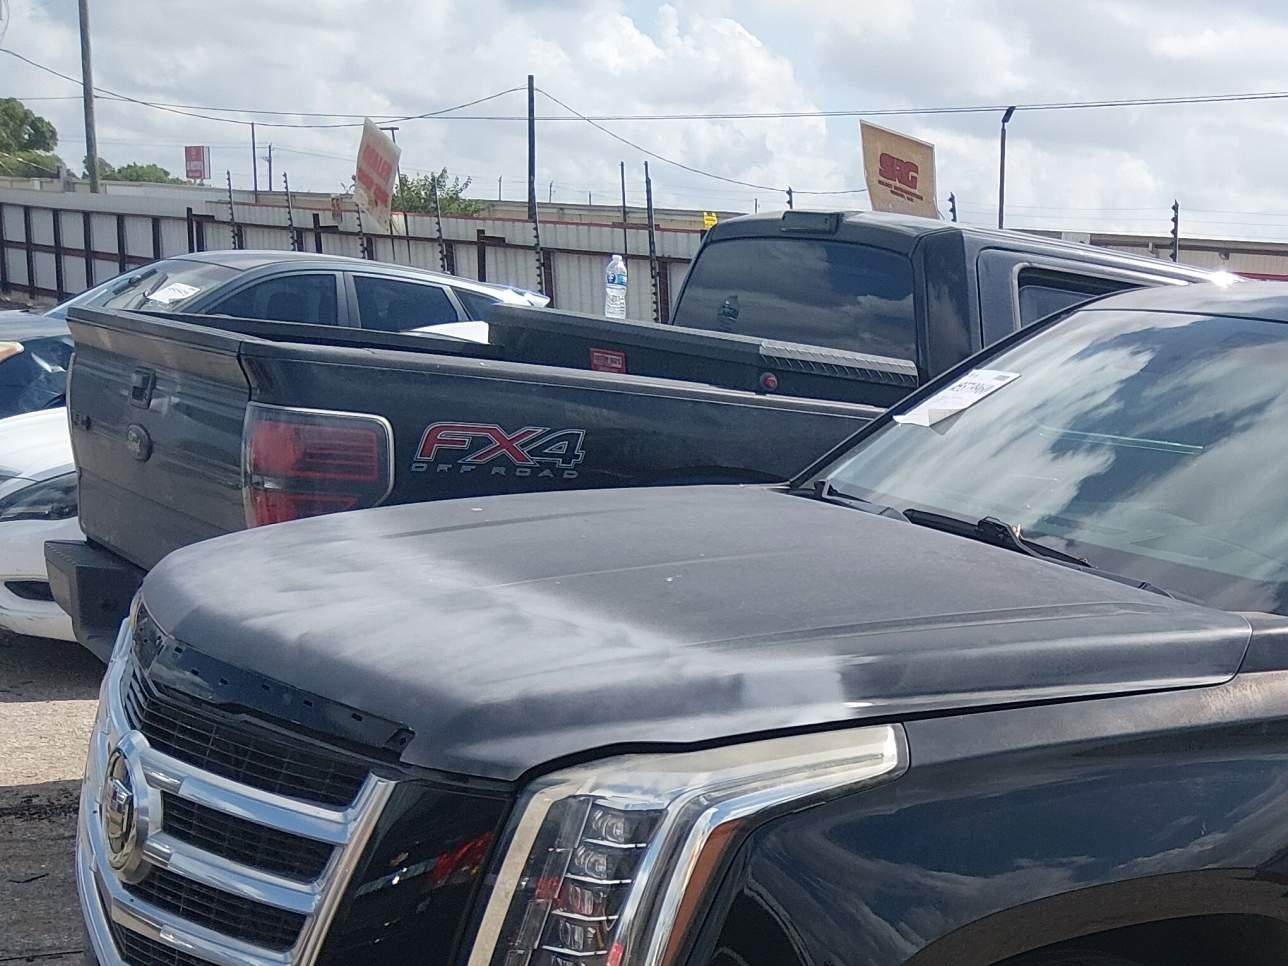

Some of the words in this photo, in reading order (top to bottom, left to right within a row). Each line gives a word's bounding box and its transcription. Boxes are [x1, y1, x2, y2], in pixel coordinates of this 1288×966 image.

[413, 421, 587, 469] FX4
[411, 462, 477, 474] OFF
[491, 466, 580, 479] ROAD
